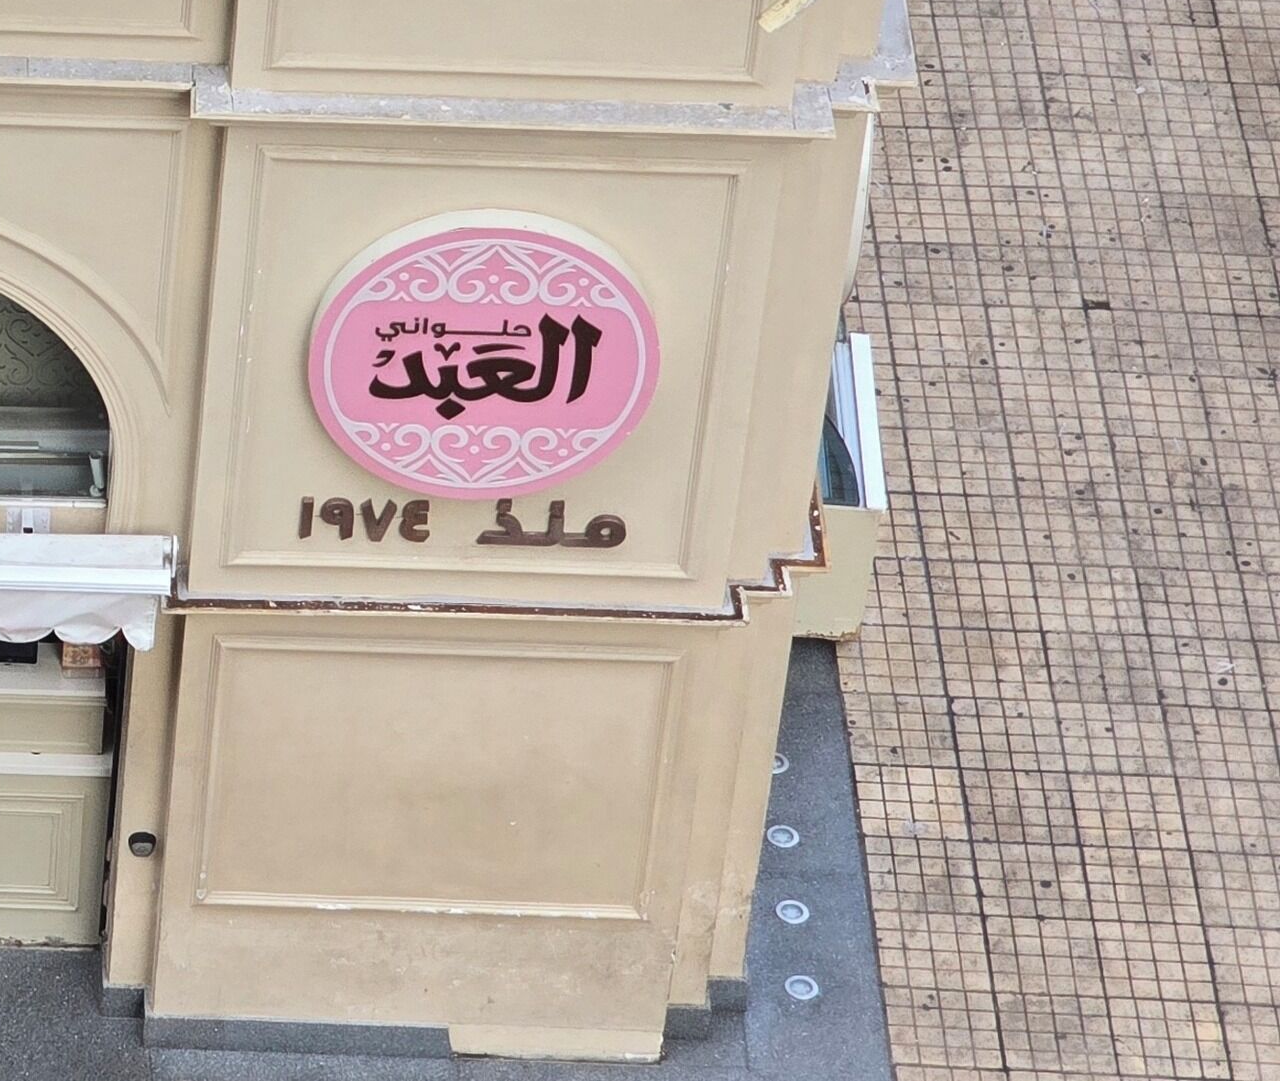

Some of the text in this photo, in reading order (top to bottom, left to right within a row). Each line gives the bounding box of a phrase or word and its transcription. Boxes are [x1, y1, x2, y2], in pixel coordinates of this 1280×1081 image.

[375, 317, 532, 341] حلواني
[298, 496, 627, 548] منذ ١٩٧٤
